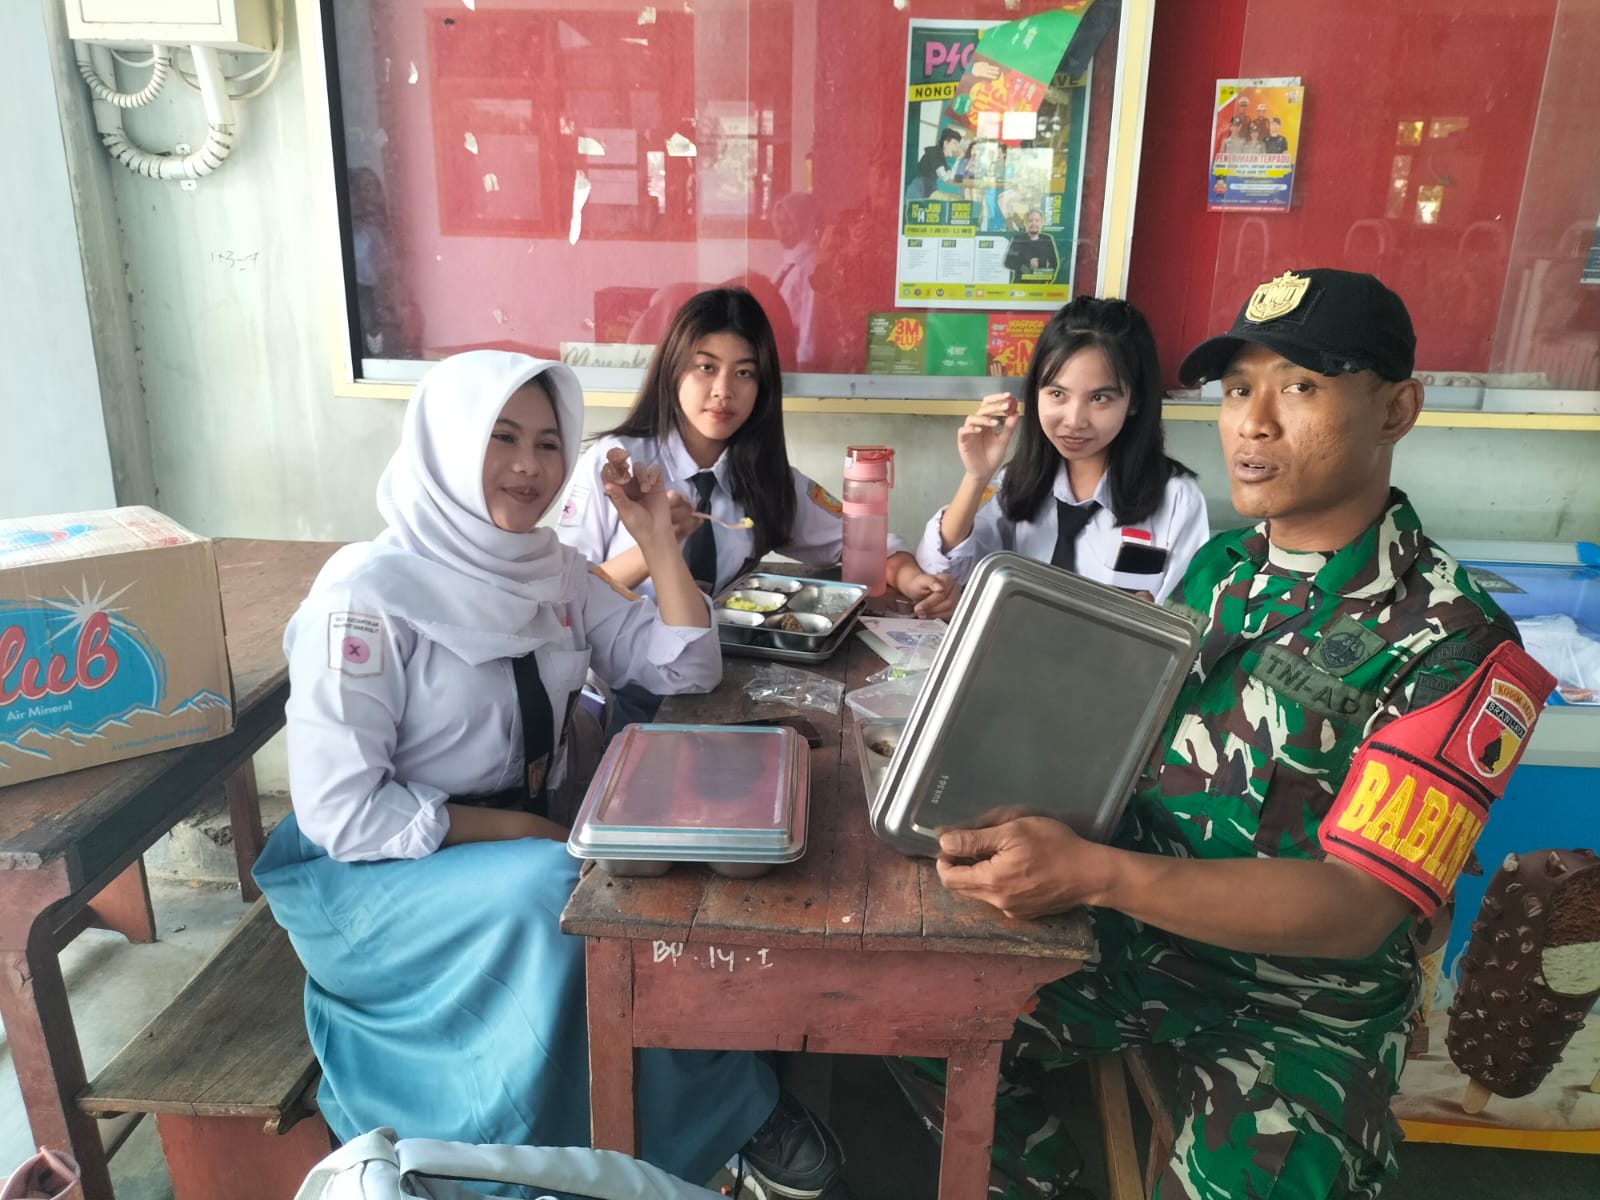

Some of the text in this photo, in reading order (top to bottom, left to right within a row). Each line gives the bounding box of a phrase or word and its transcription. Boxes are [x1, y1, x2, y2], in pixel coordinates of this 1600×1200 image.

[895, 319, 920, 335] 3M
[894, 335, 921, 346] PLUS
[0, 611, 118, 706] lub
[1264, 653, 1361, 715] TNI-AD
[7, 699, 73, 721] Air Mineral
